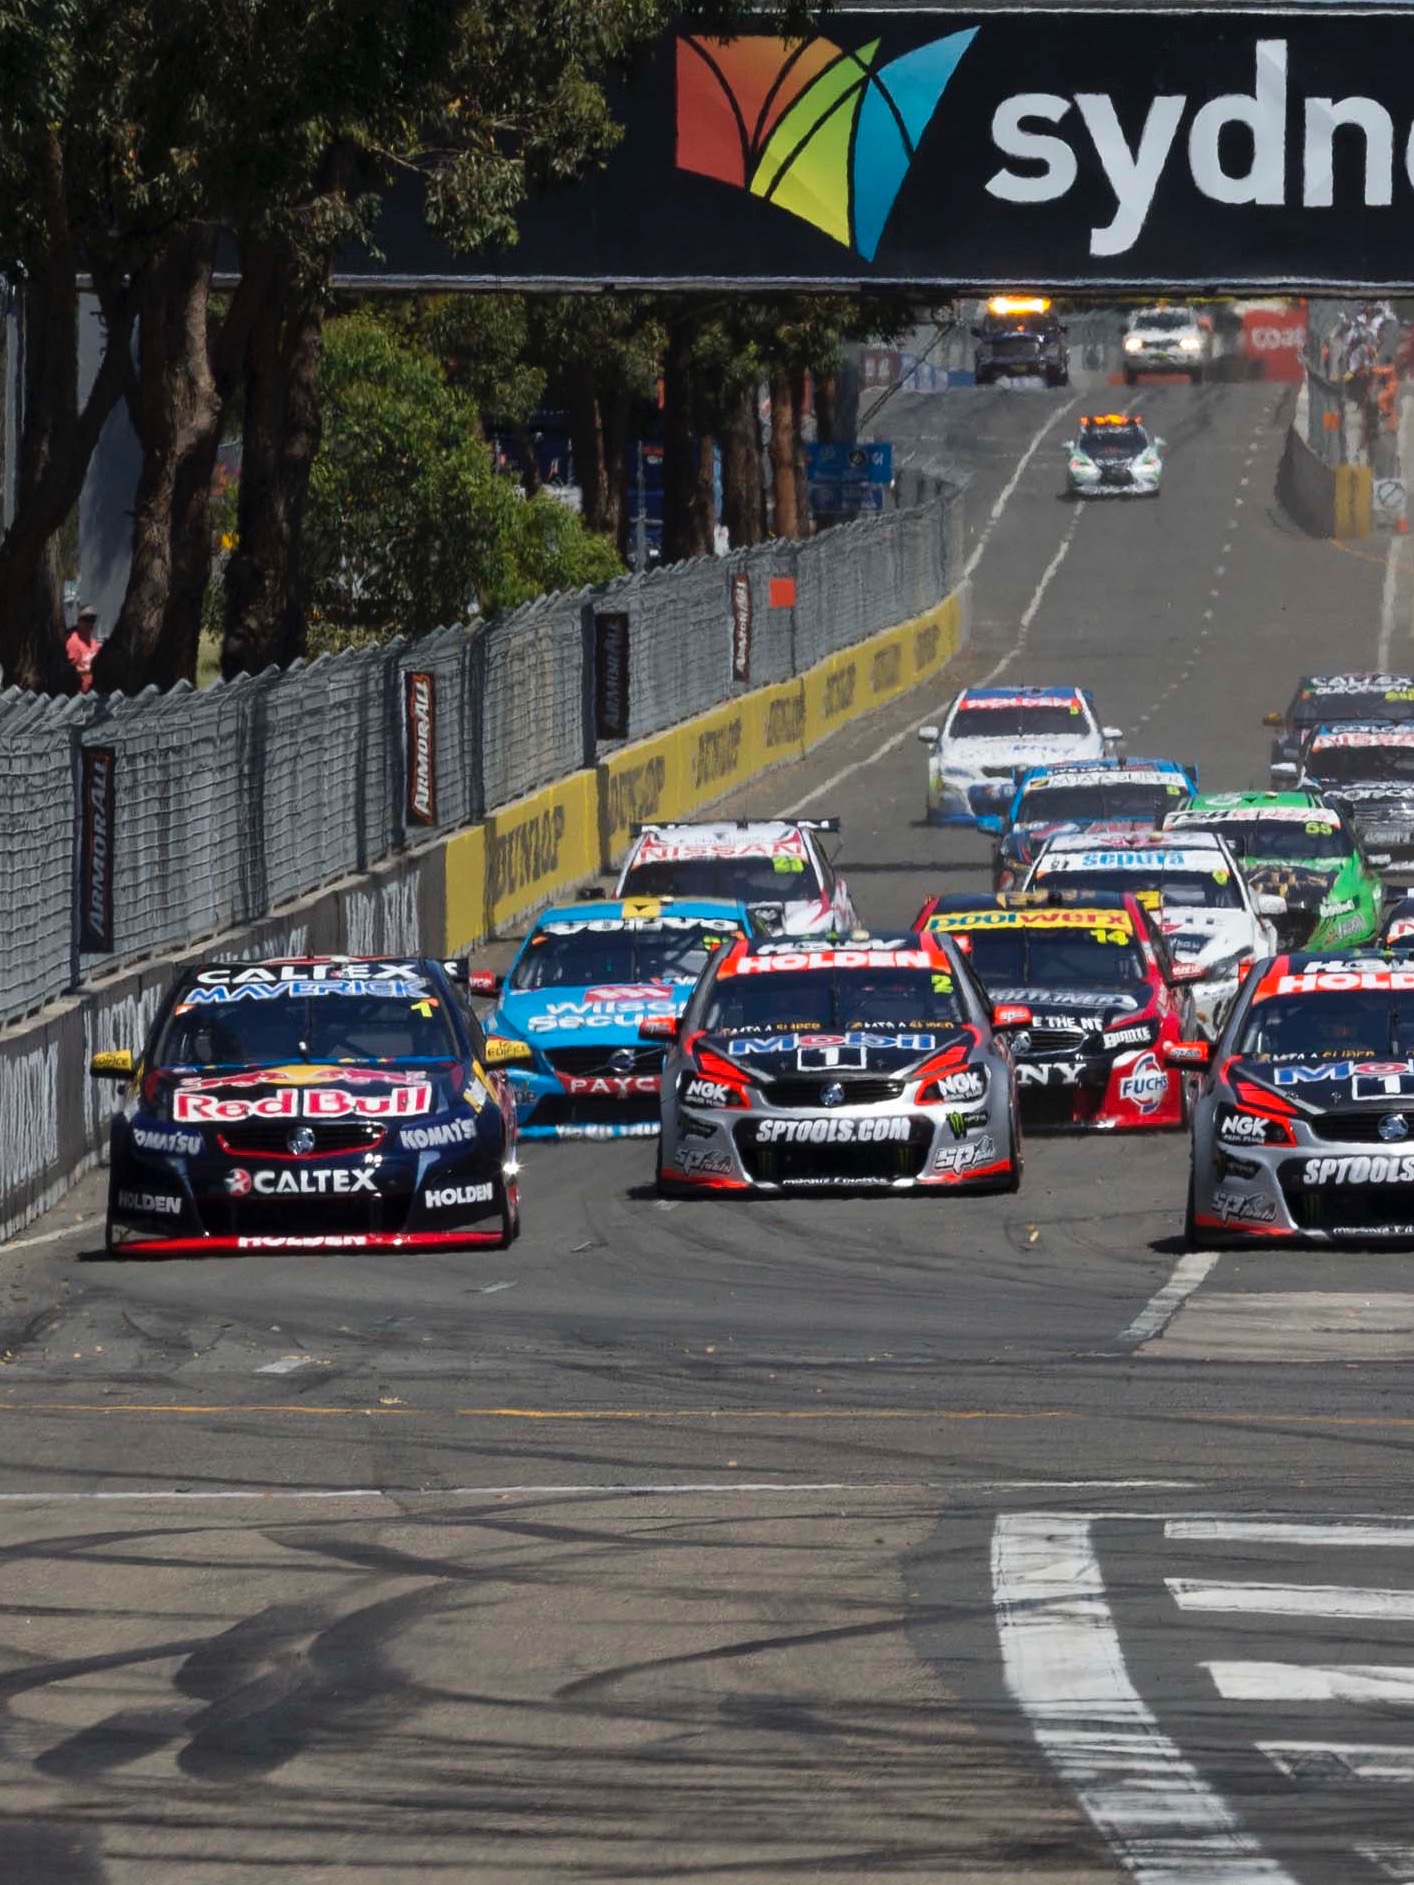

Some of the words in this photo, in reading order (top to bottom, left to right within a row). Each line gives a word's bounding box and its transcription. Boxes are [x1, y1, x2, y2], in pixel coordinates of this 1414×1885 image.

[413, 680, 431, 816] ARMORALL
[90, 761, 107, 938] ARMORALL
[640, 843, 801, 863] NISSAN
[1081, 850, 1186, 868] sepura
[928, 912, 1125, 931] poolwerx
[1090, 929, 1130, 946] 14
[197, 963, 420, 984] CALTEX
[736, 950, 931, 974] HOLDEN
[185, 979, 435, 1004] MAVERICK
[930, 975, 954, 994] 2
[411, 1001, 433, 1018] 1
[1042, 1016, 1076, 1029] THE
[728, 1032, 936, 1055] Mobil
[570, 1076, 656, 1093] PAYC
[686, 1079, 731, 1102] NGK
[937, 1071, 984, 1097] NGK
[1122, 1073, 1168, 1096] FUCHS
[175, 1089, 298, 1122] Red
[304, 1081, 431, 1118] Bull
[400, 1117, 478, 1150] KOMATS
[755, 1116, 911, 1143] SPTOOLS.COM
[1221, 1114, 1271, 1137] NGK
[253, 1168, 378, 1194] CALTEX
[118, 1190, 182, 1214] HOLDEN
[425, 1182, 493, 1209] HOLDEN
